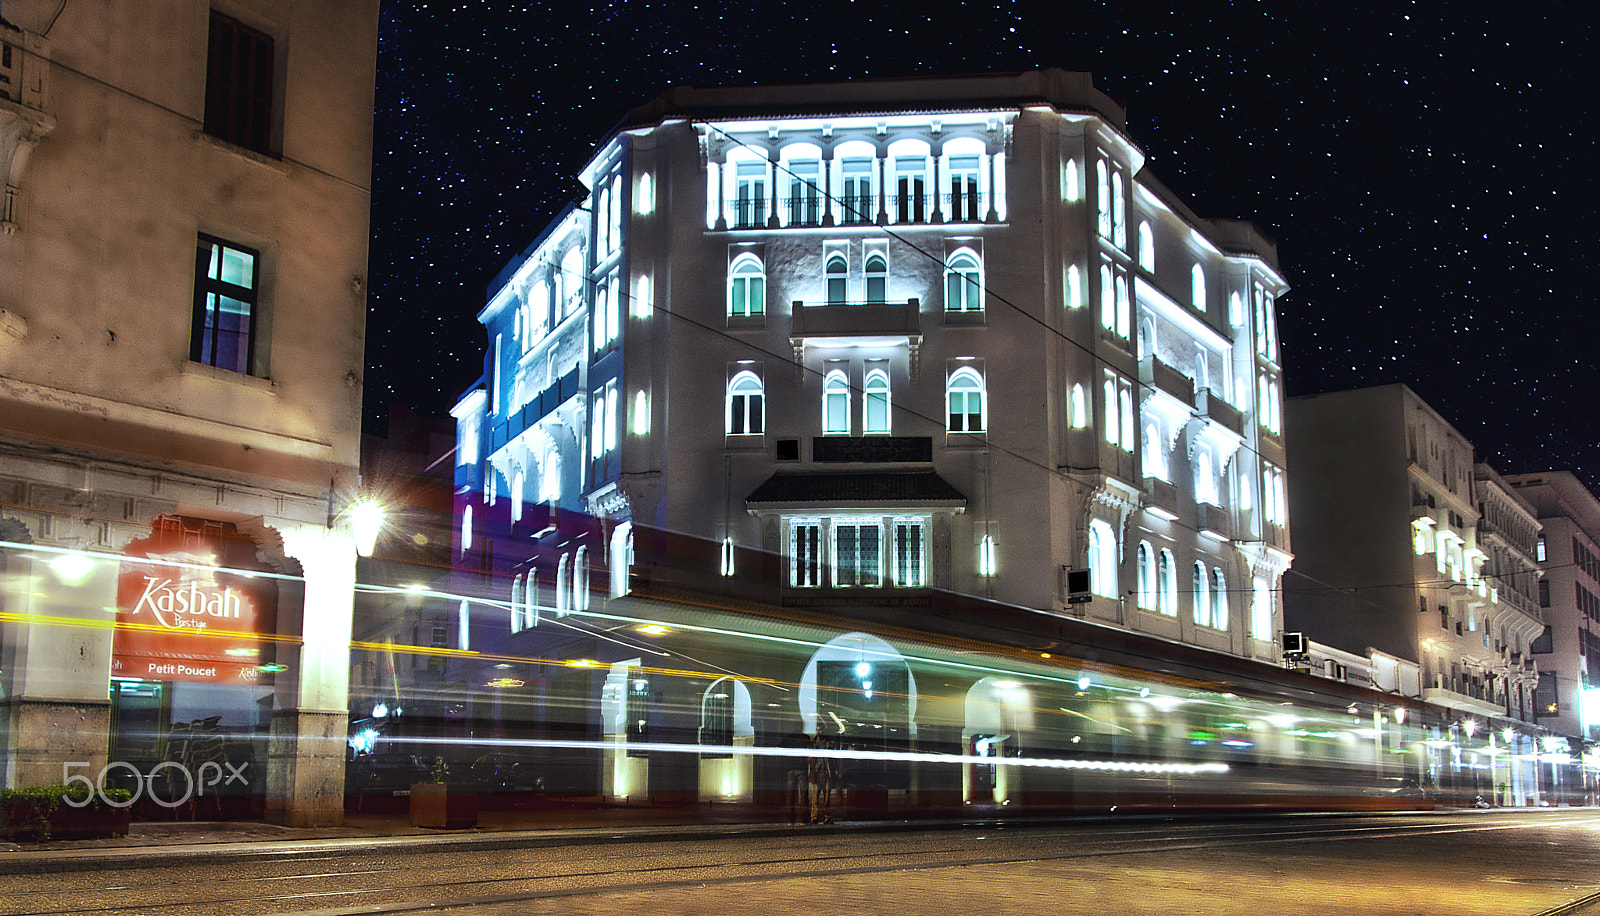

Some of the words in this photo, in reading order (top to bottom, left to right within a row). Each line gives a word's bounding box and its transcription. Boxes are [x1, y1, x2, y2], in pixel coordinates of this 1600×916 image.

[132, 575, 240, 629] Kasbah
[173, 612, 208, 634] Prestige
[148, 663, 175, 674] Petit
[177, 664, 216, 676] Poucet
